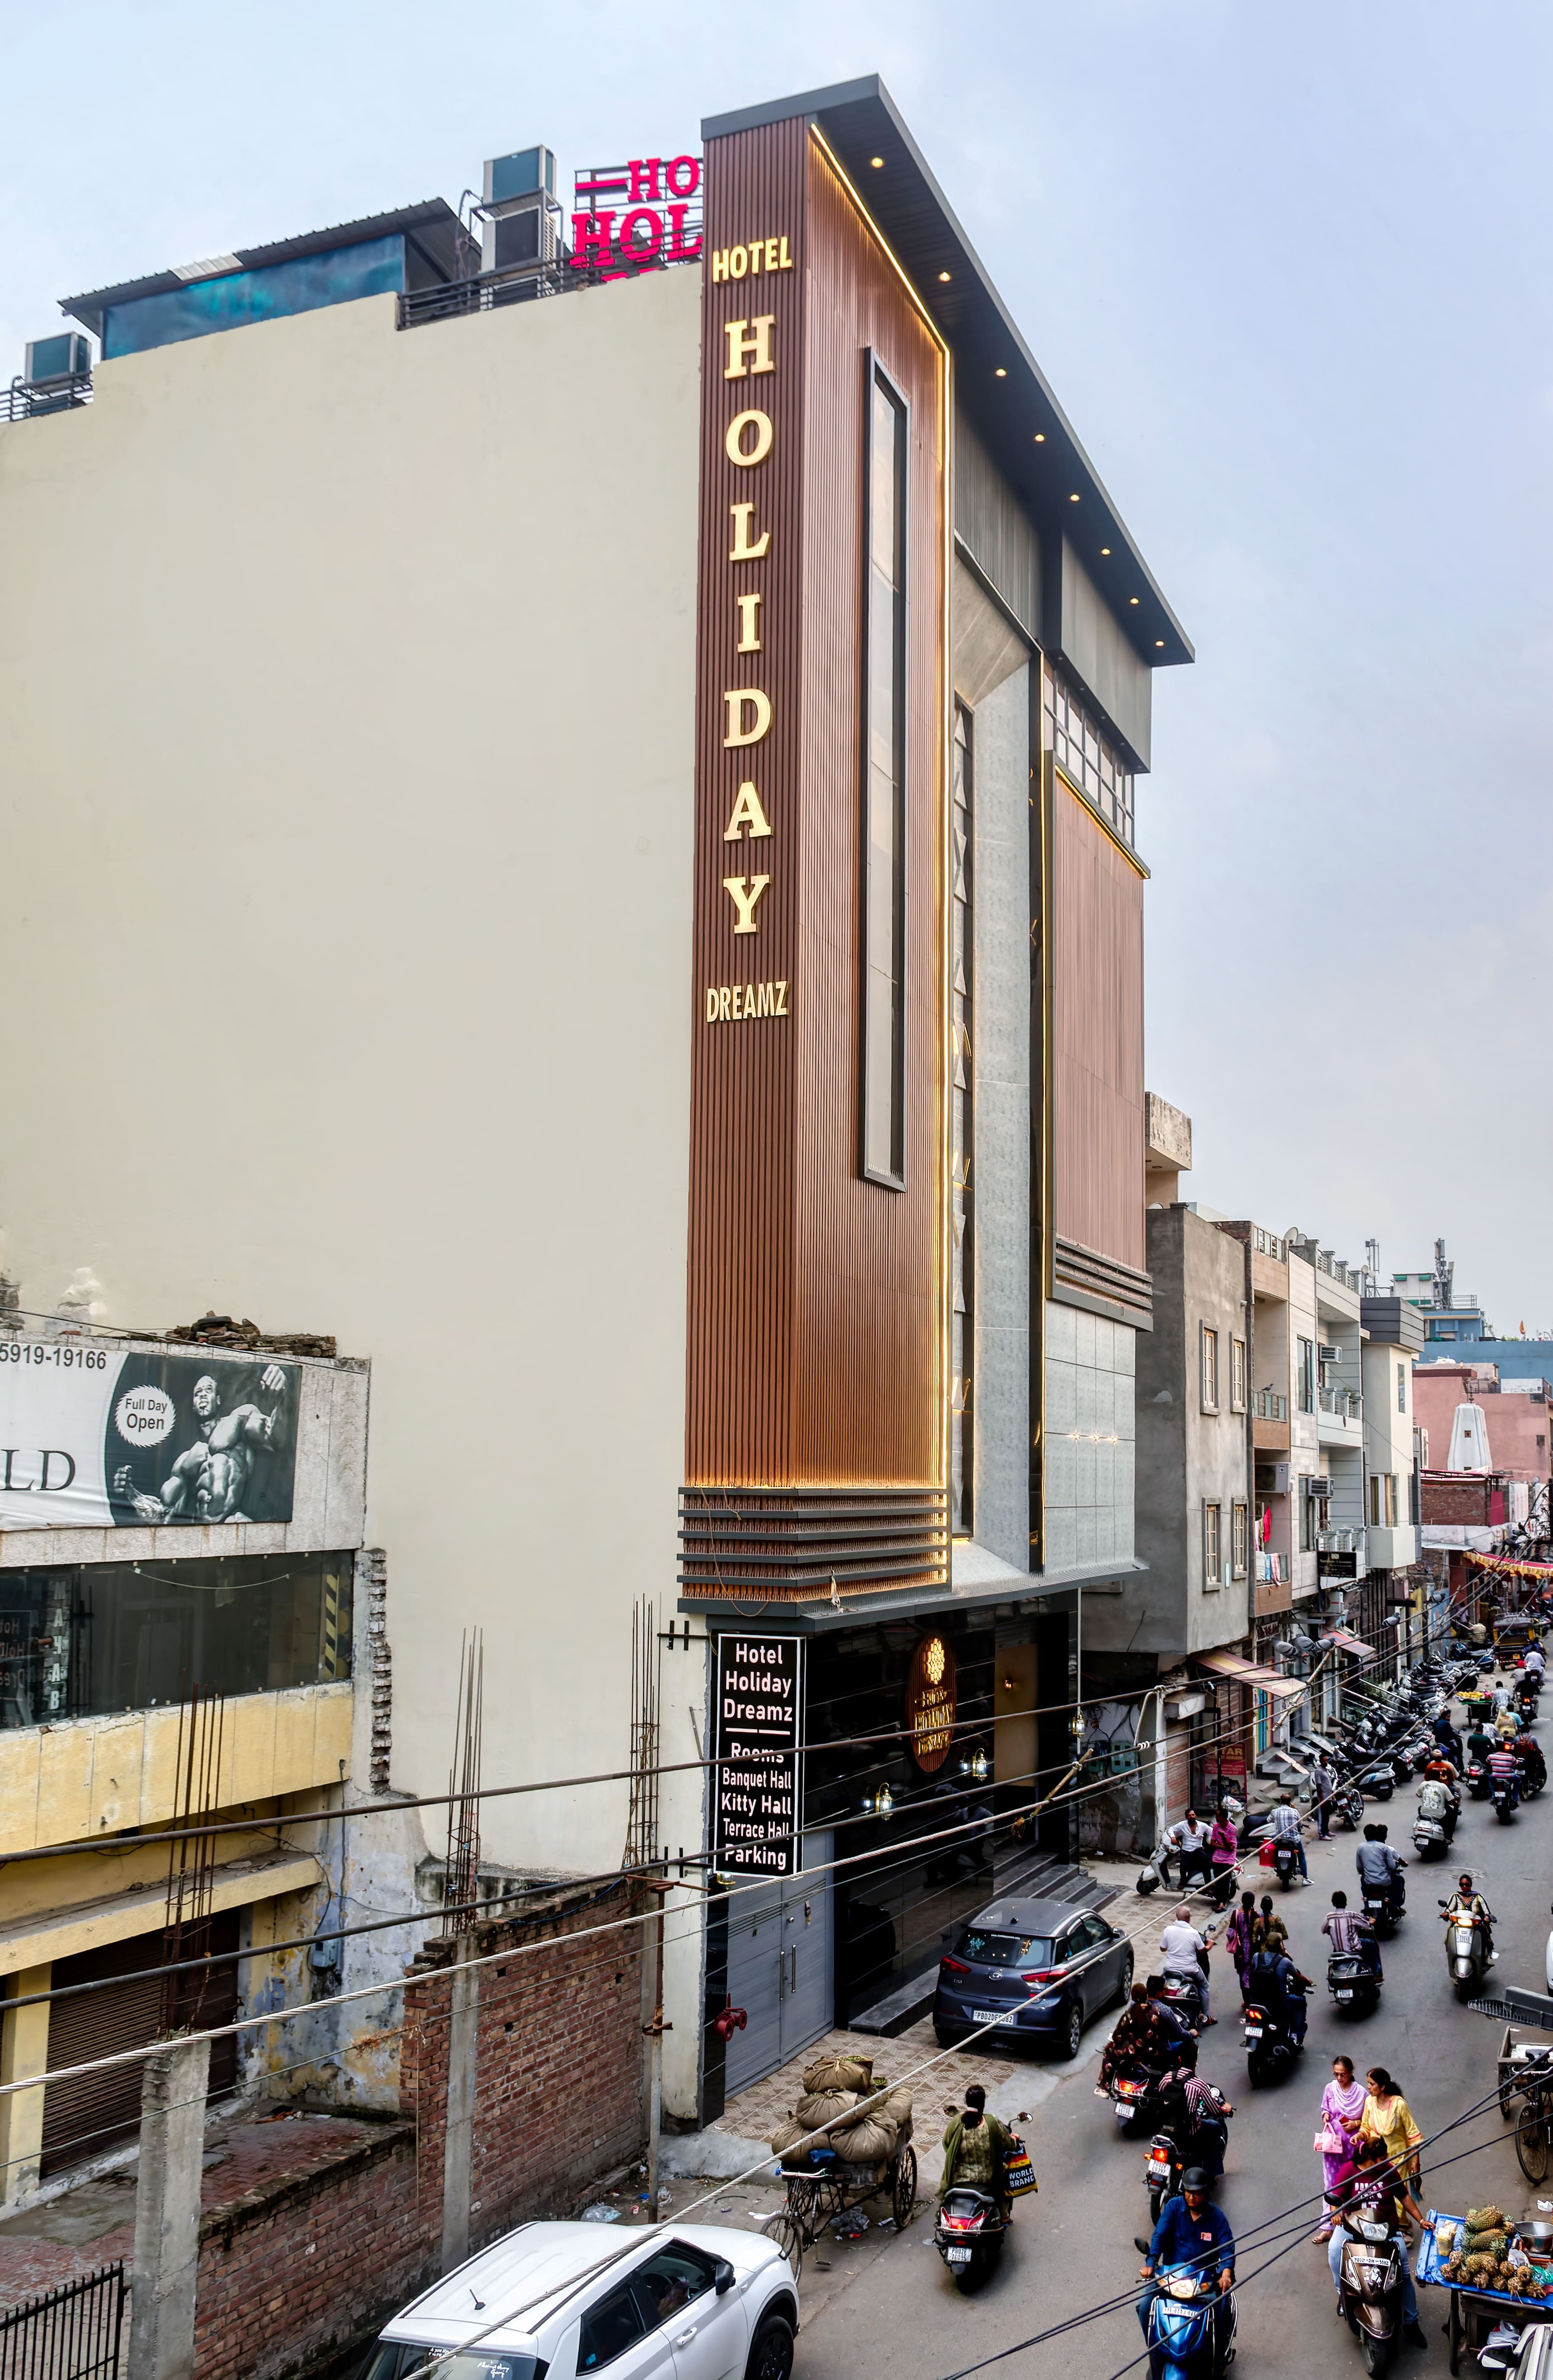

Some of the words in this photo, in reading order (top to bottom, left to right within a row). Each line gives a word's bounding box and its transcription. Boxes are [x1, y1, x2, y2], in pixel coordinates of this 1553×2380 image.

[713, 236, 792, 283] HOTEL
[723, 315, 775, 934] HOLIDAY
[706, 980, 789, 1022] DREAMZ
[0, 1342, 107, 1369] 5919-19166
[125, 1398, 145, 1410] Full
[148, 1399, 167, 1414] Day
[127, 1413, 164, 1432] Open
[736, 1643, 783, 1664] Hotel
[726, 1671, 792, 1698] Holiday
[724, 1698, 792, 1721] Dreamz
[723, 1767, 766, 1791] Banquet
[770, 1770, 791, 1789] Hall
[721, 1792, 756, 1816] Kitty
[761, 1795, 791, 1815] Hall
[723, 1818, 764, 1838] Terrace
[768, 1821, 789, 1840] Hall
[725, 1843, 786, 1870] Parking
[1009, 2168, 1034, 2179] WORLD
